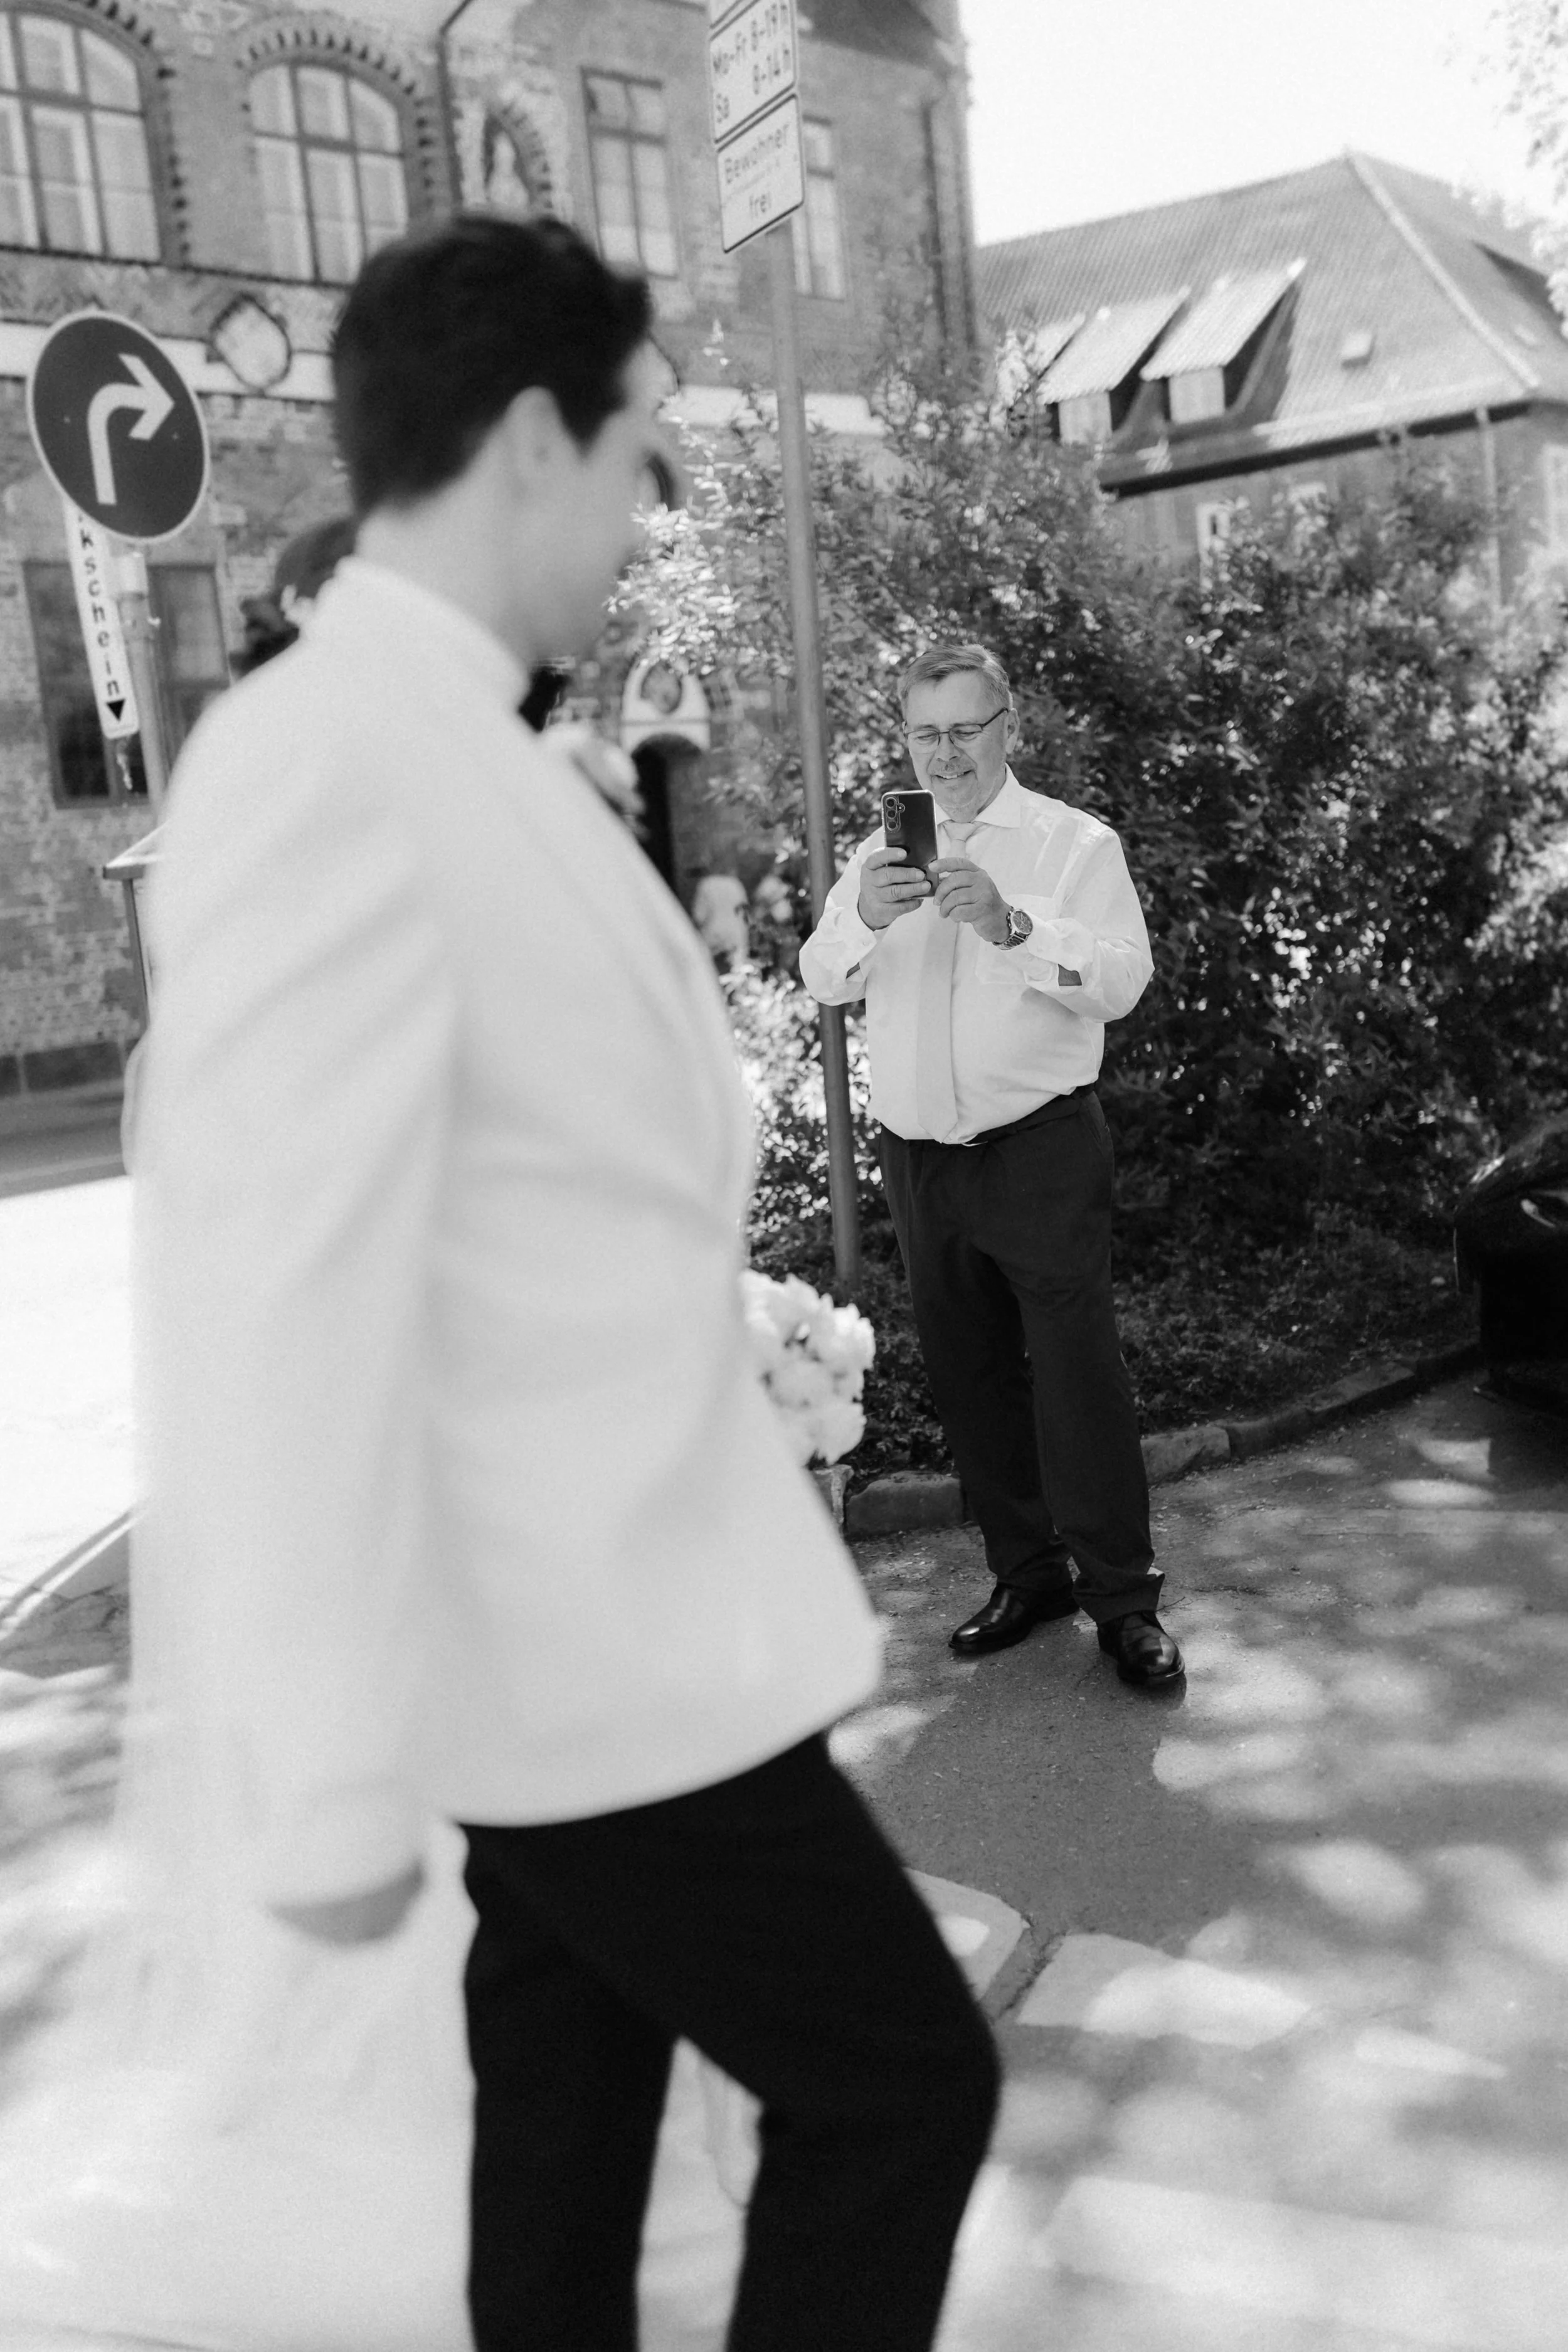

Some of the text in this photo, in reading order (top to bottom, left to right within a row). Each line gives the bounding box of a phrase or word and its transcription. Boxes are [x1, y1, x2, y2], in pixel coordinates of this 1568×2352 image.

[725, 124, 790, 184] Bewohner
[750, 192, 771, 218] frei
[78, 515, 119, 696] kschein
